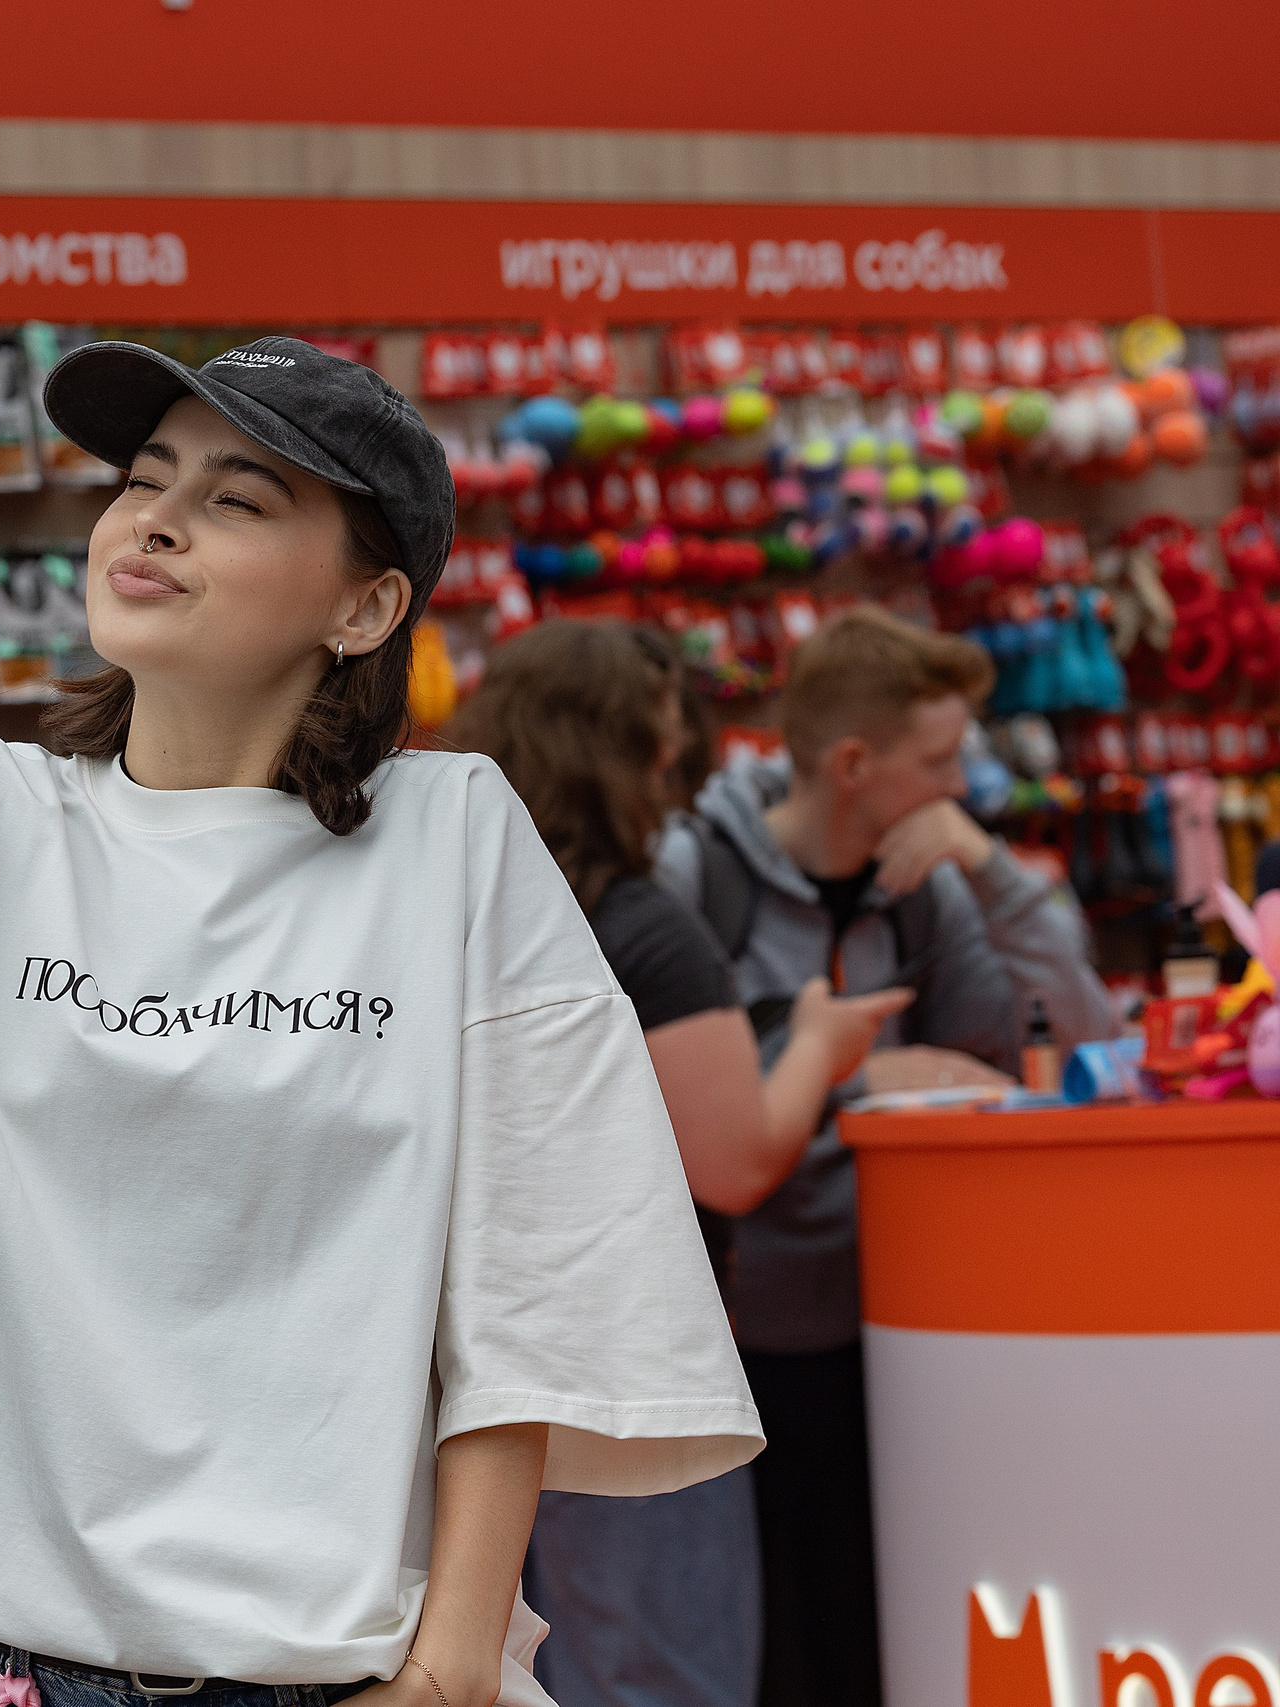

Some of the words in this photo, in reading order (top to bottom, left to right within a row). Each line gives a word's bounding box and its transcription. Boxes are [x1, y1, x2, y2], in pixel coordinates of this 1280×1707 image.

[499, 238, 738, 300] игрушки
[746, 240, 847, 299] для
[853, 228, 1008, 292] собак
